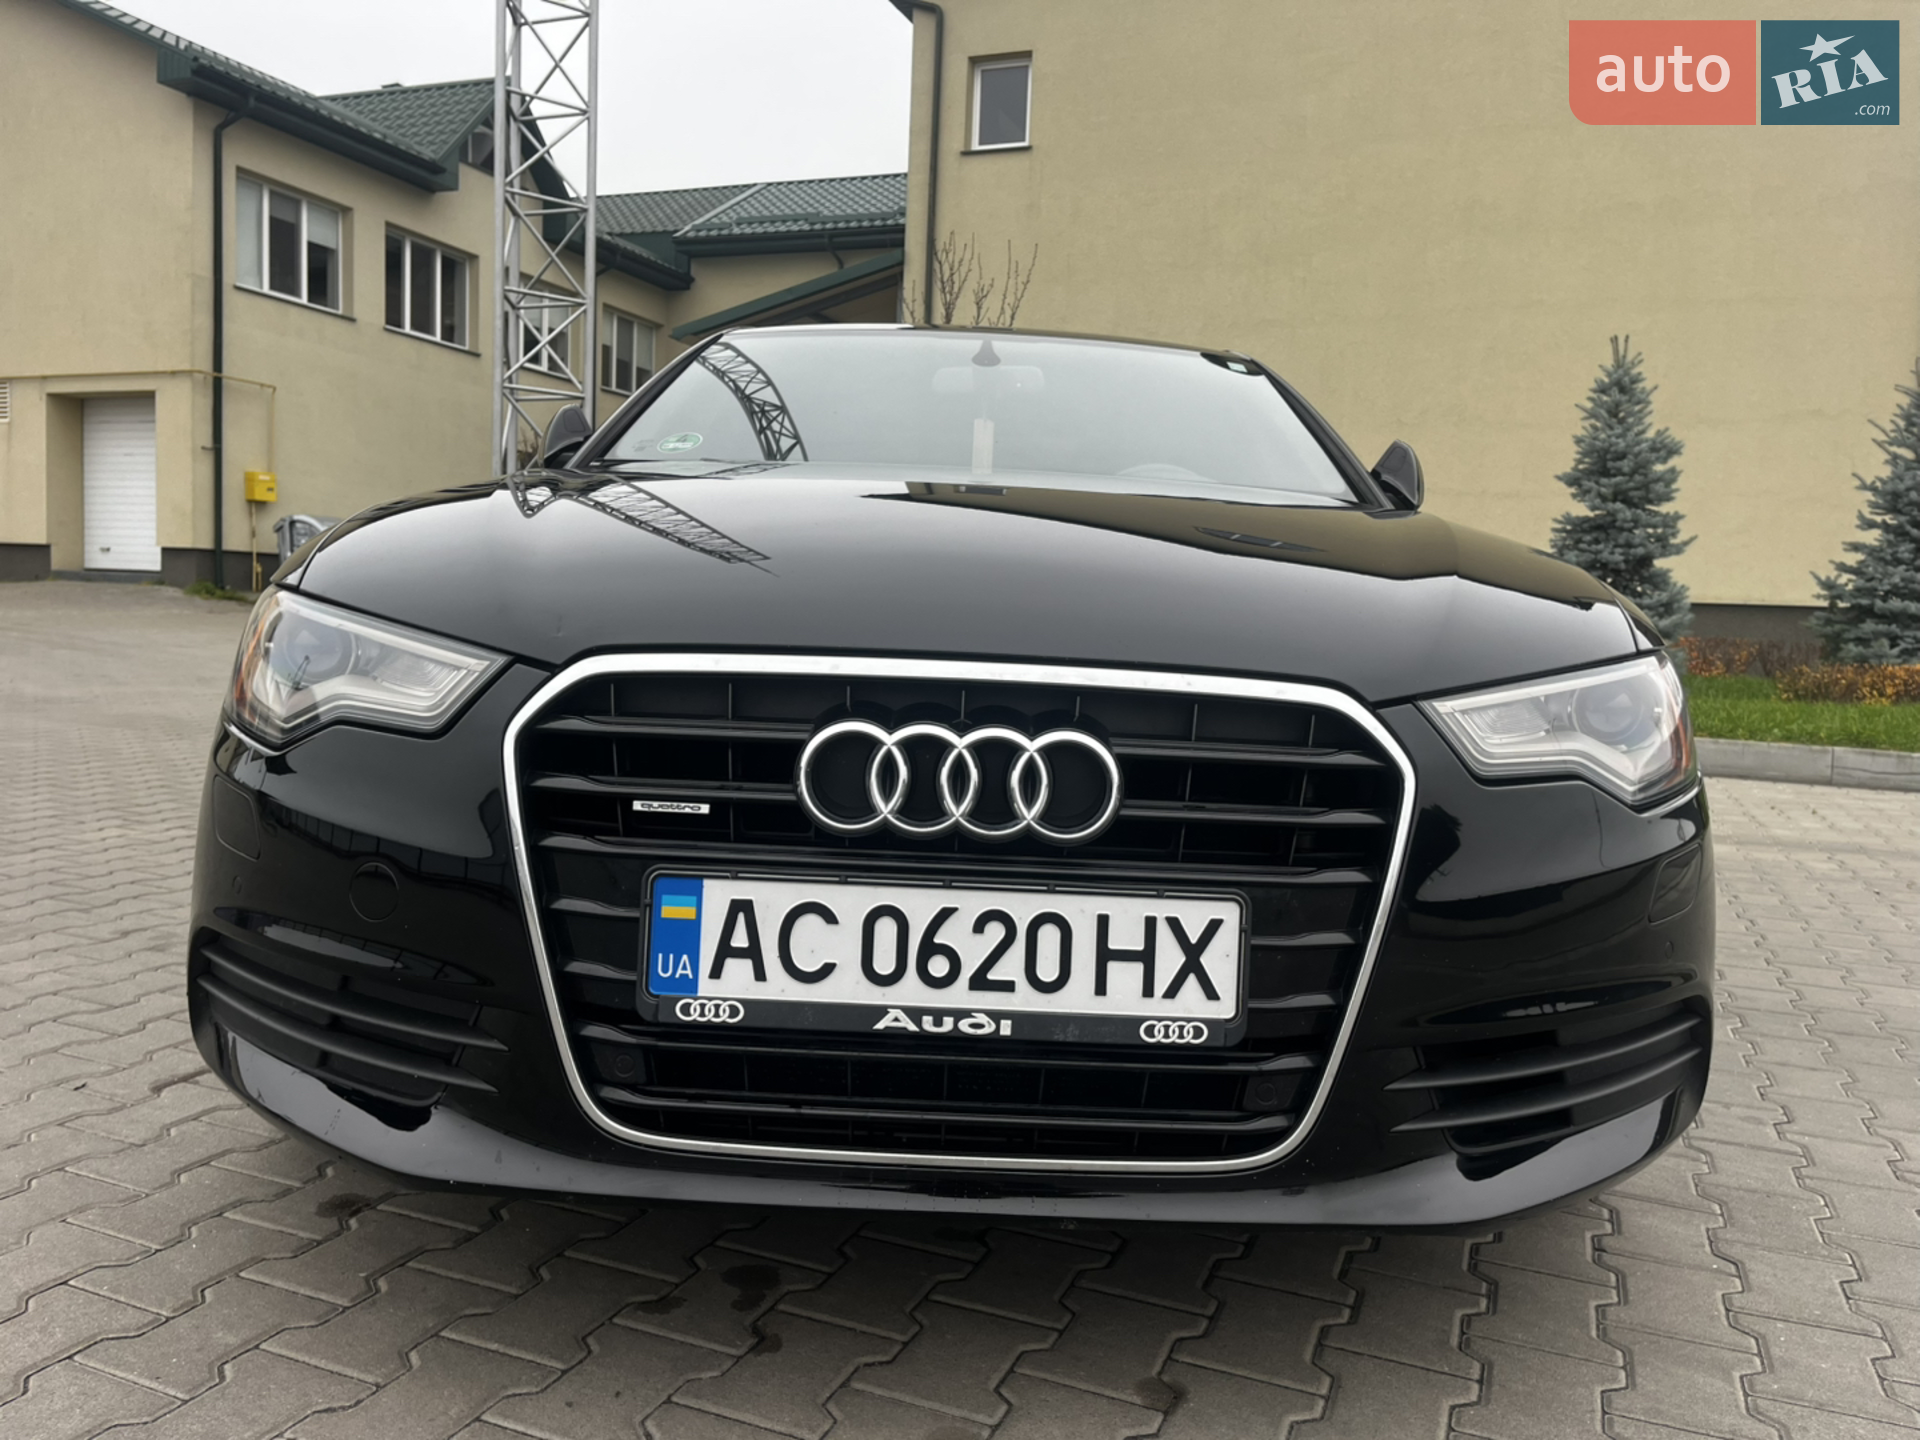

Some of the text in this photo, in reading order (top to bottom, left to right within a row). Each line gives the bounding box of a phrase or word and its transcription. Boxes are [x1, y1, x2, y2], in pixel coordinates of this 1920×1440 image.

[641, 802, 702, 812] quattro
[708, 898, 1224, 1000] AC 0620 HX
[657, 952, 693, 979] UA
[872, 1008, 1012, 1036] Audi
